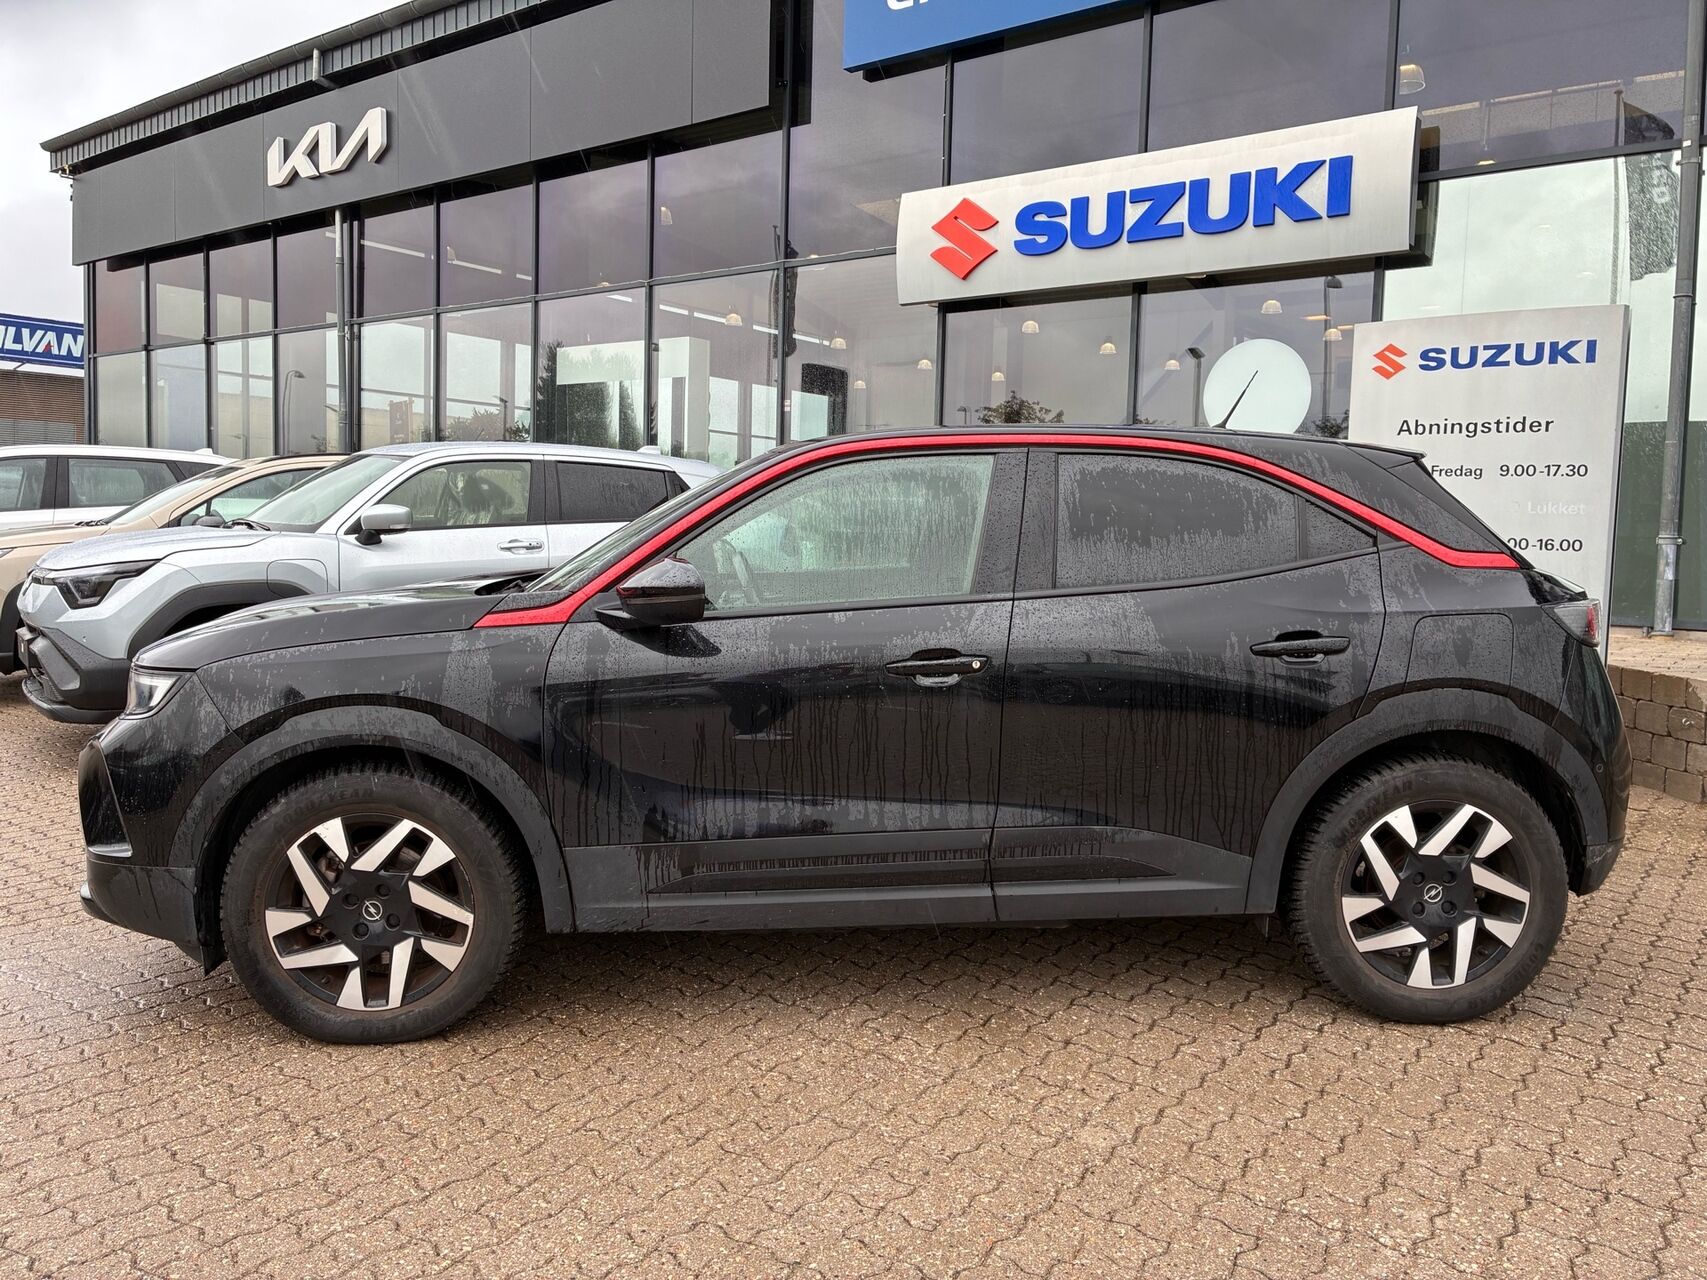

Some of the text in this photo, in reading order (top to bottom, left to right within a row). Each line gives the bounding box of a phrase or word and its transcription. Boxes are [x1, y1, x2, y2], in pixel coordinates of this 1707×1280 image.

[267, 106, 387, 188] KIA
[1013, 155, 1354, 257] SUZUKI
[1418, 339, 1598, 371] SUZUKI
[1430, 464, 1484, 480] Fredag
[1527, 501, 1586, 516] Lukket
